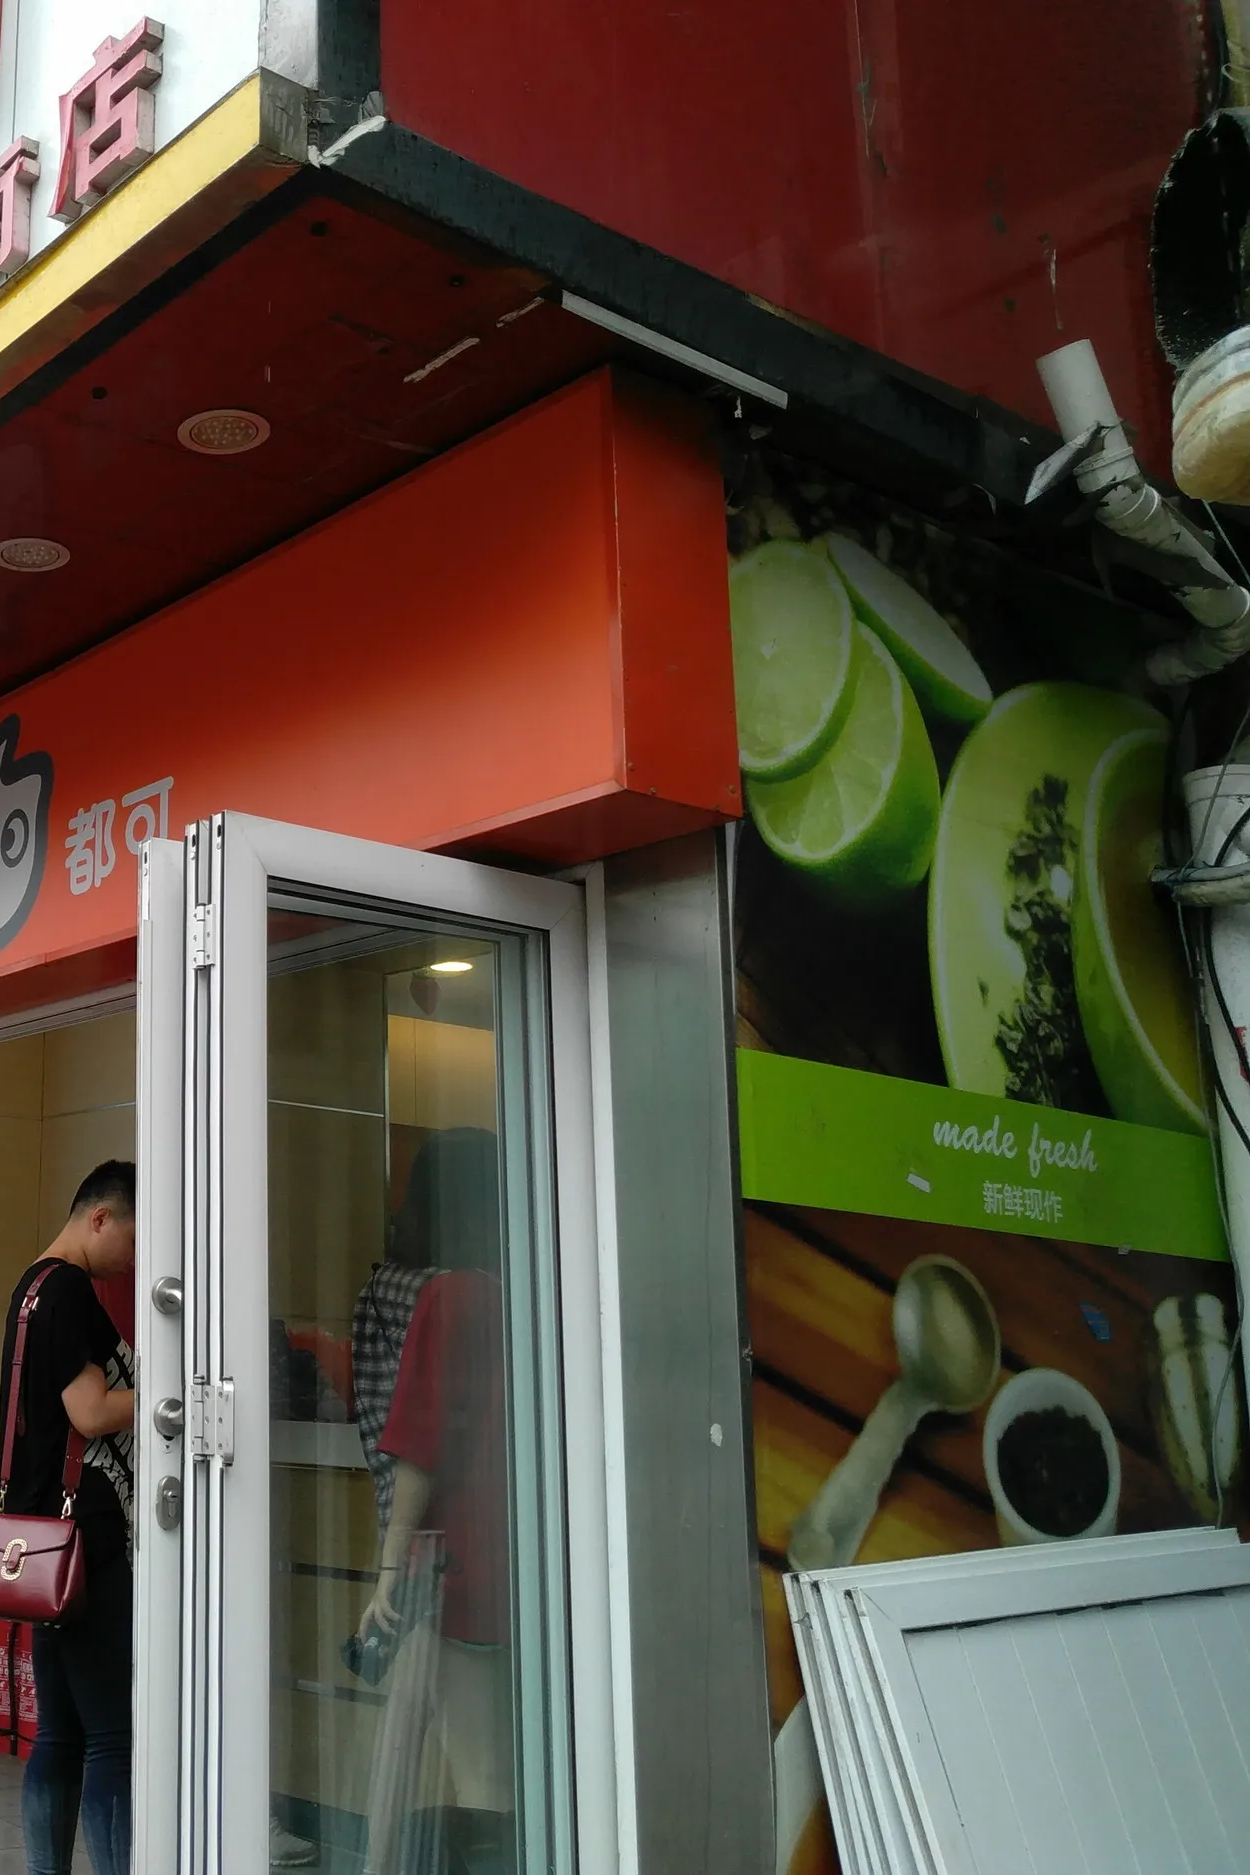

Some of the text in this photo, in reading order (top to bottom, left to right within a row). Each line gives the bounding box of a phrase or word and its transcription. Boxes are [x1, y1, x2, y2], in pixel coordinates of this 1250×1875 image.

[64, 776, 175, 896] 都可
[933, 1114, 1098, 1179] made fresh
[983, 1180, 1064, 1224] 新鲜现作
